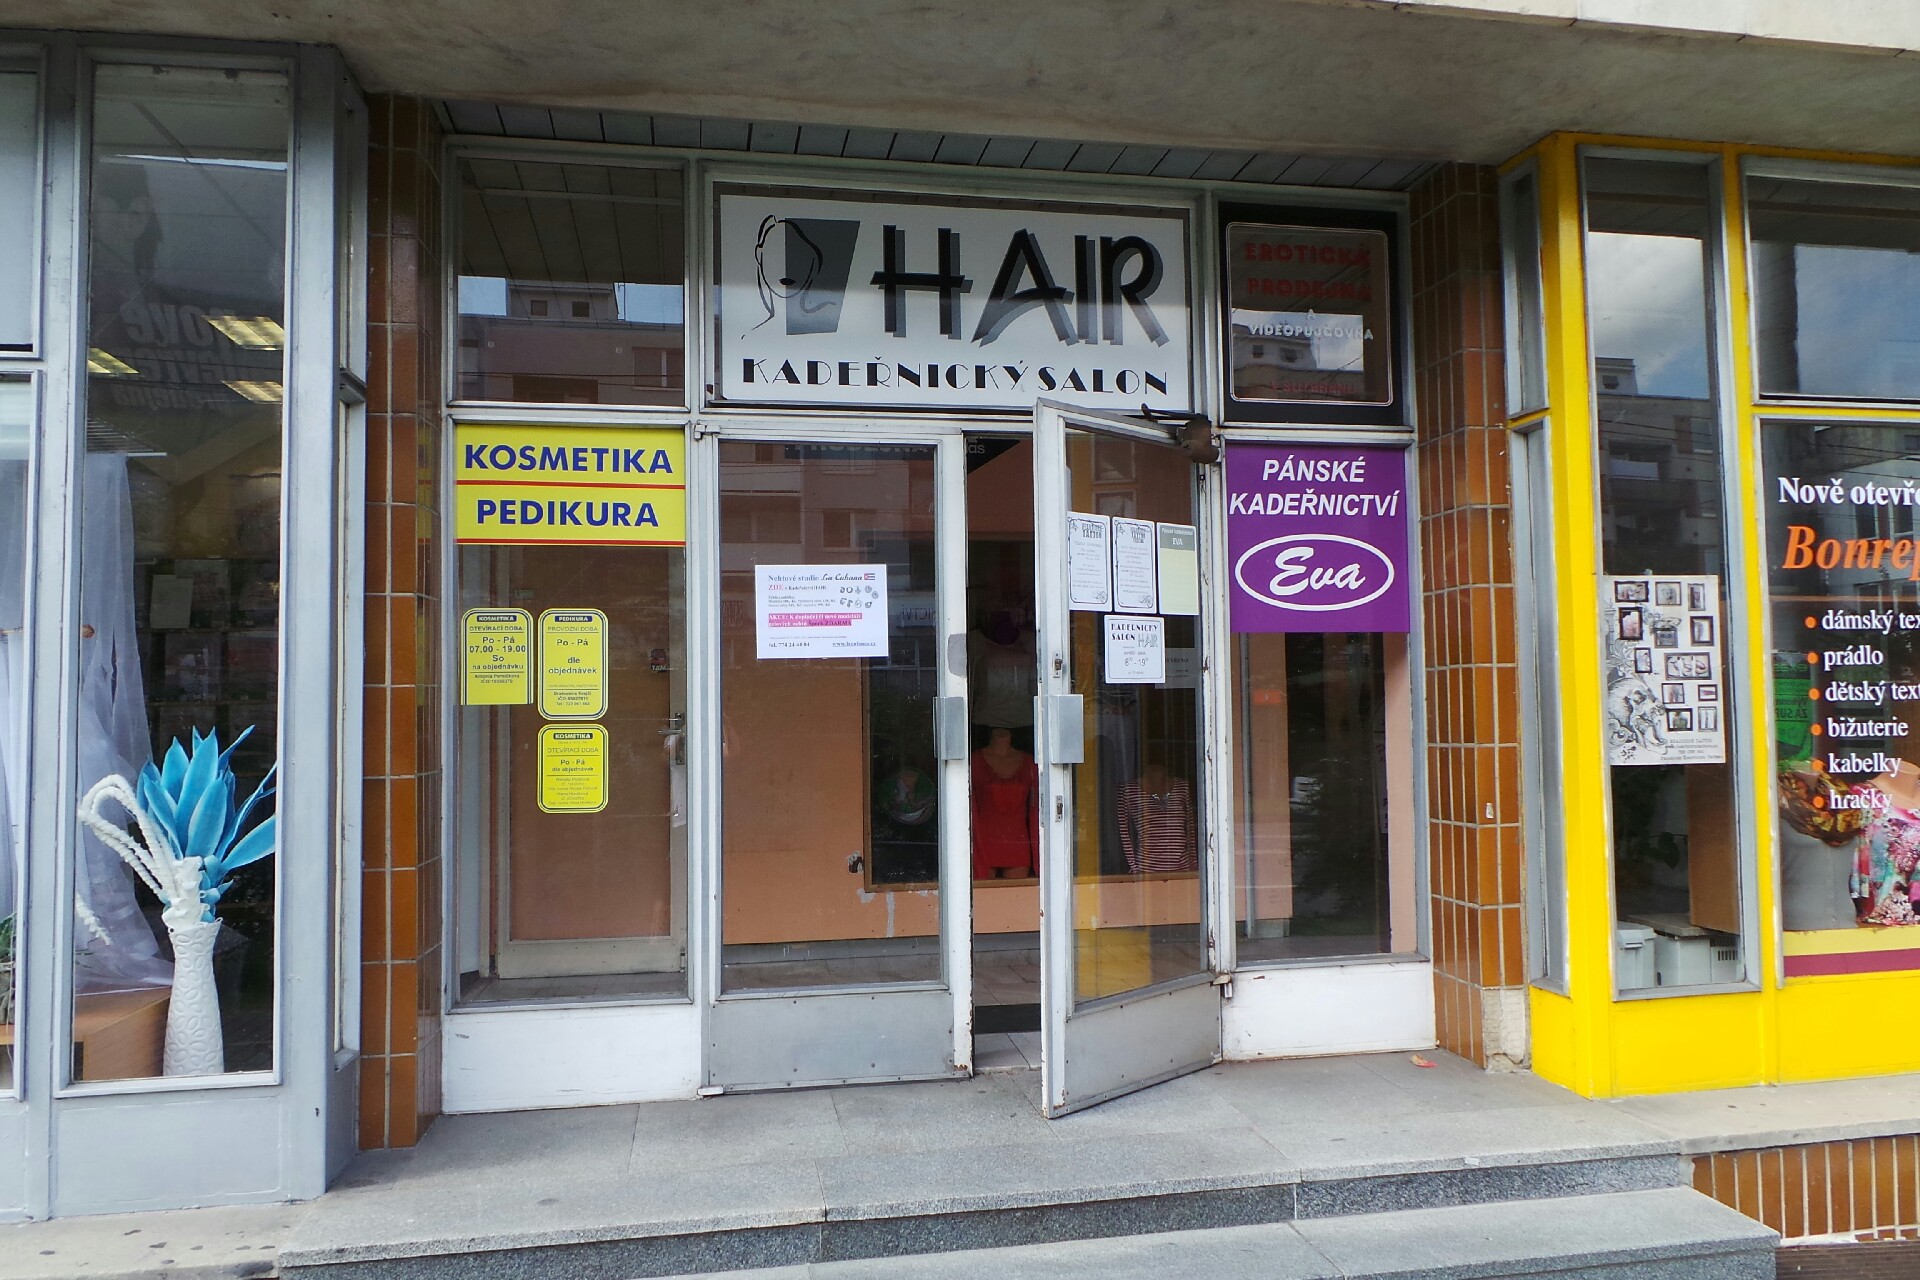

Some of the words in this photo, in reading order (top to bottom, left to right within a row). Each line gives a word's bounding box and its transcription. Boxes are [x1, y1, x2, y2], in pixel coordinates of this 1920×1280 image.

[869, 224, 1170, 347] HAIR
[1307, 308, 1315, 320] A
[743, 356, 1029, 391] KADEŘNICKÝ
[1038, 365, 1168, 395] SALON
[465, 444, 673, 474] KOSMETIKA
[1262, 455, 1366, 482] PÁNSKÉ
[1229, 488, 1400, 517] KADEŘNICTVÍ
[1777, 477, 1844, 504] Nově
[477, 499, 659, 527] PEDIKURA
[1172, 537, 1183, 546] EVA
[1269, 546, 1366, 596] Eva
[1821, 609, 1893, 635] dámský
[469, 645, 494, 653] 07.00
[502, 645, 526, 653] 19.00
[482, 636, 495, 644] Po
[503, 636, 515, 644] Pá
[577, 638, 589, 646] Pá
[492, 654, 505, 662] So
[1823, 645, 1884, 671] prádlo
[548, 667, 597, 676] objednávek
[1824, 680, 1886, 706] dětský
[1827, 716, 1909, 737] bižuterie
[1828, 753, 1902, 778] kabelky
[1829, 787, 1893, 813] hračky
